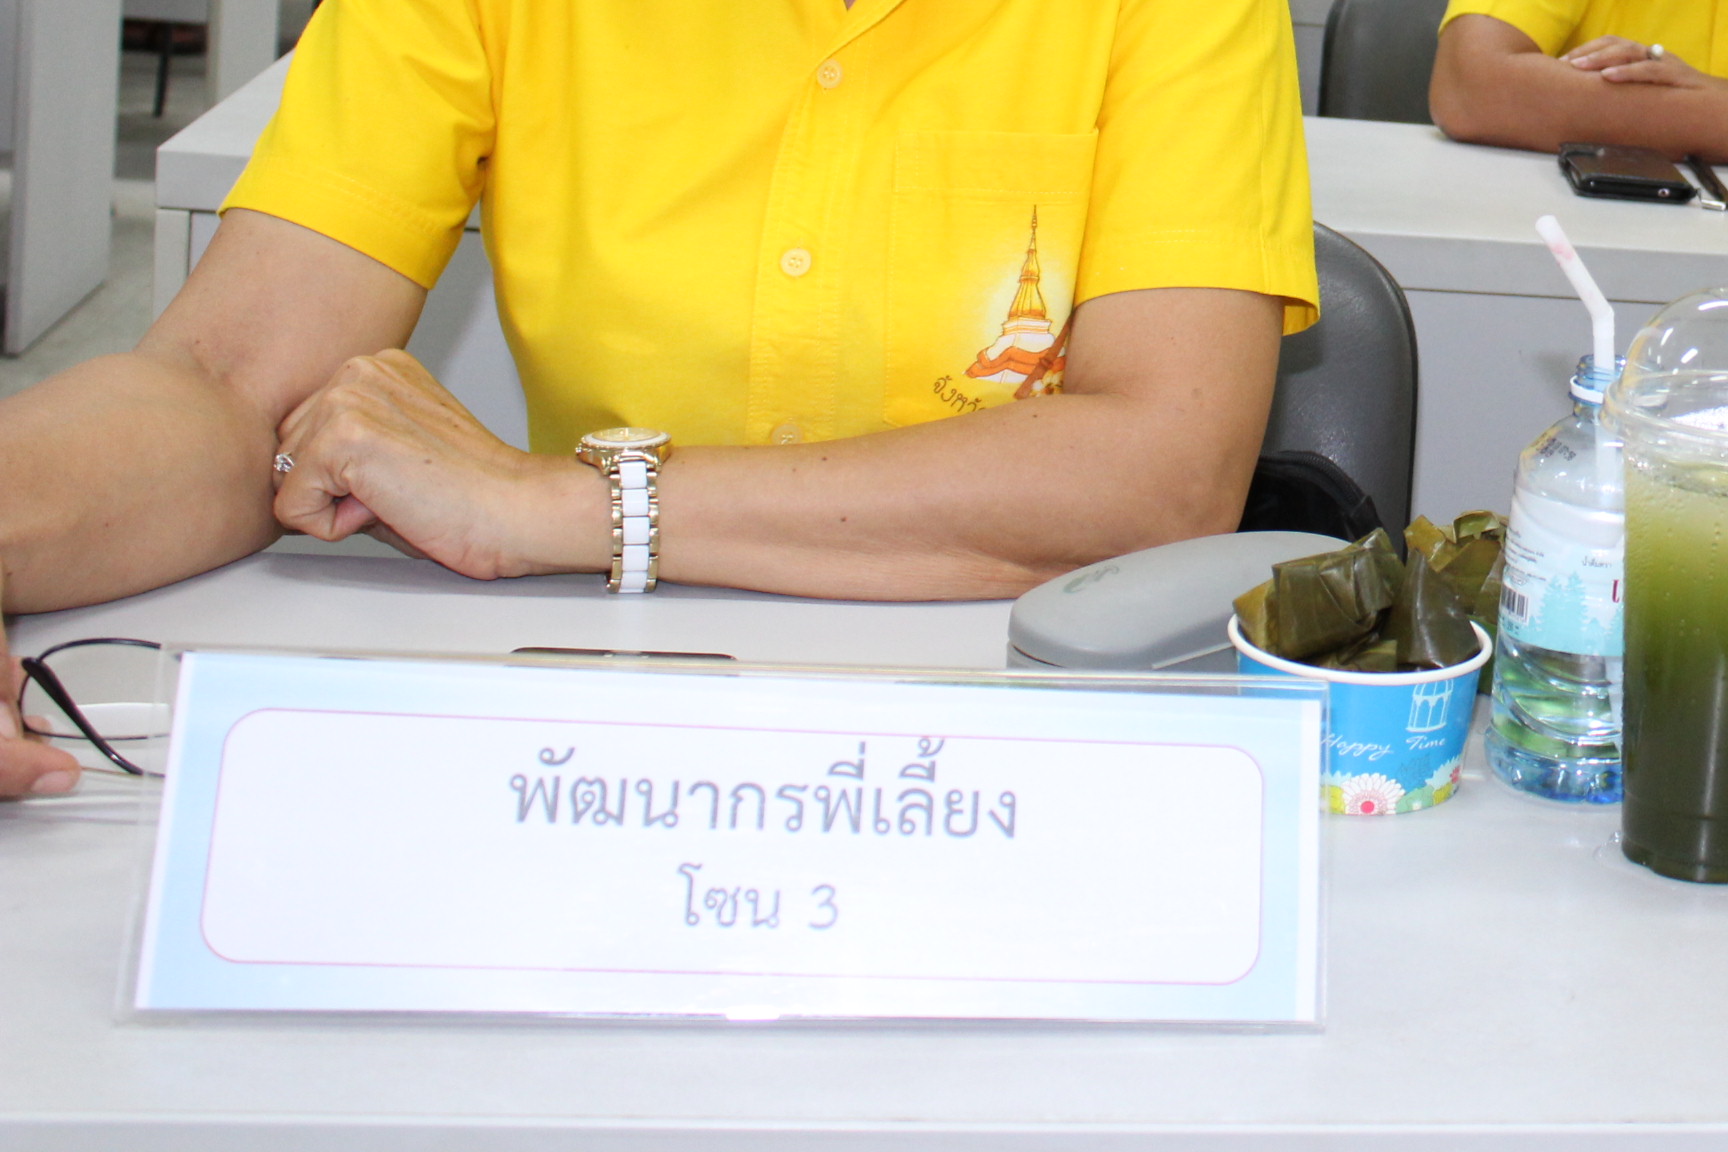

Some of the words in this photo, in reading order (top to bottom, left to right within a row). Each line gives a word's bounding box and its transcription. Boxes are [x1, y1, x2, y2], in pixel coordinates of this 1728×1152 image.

[1320, 733, 1394, 761] Happy
[1405, 735, 1446, 750] Time
[509, 736, 1018, 839] พัฒนากรพี่เลี้ยง
[677, 862, 782, 929] โซน
[807, 883, 841, 931] 3
